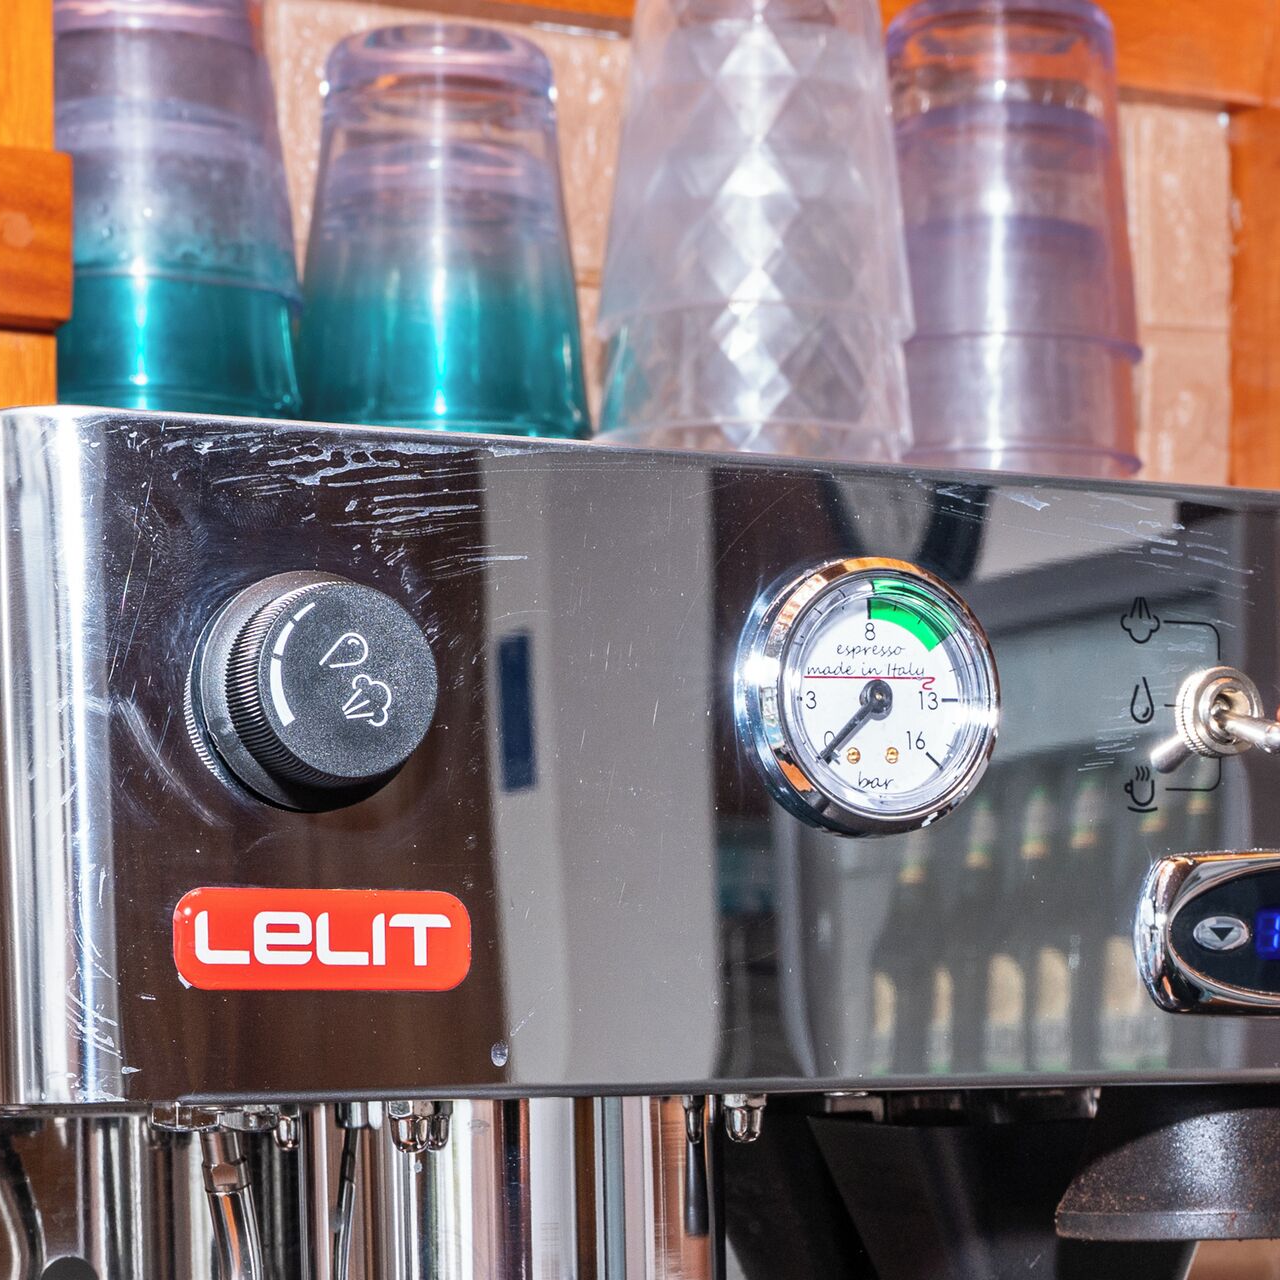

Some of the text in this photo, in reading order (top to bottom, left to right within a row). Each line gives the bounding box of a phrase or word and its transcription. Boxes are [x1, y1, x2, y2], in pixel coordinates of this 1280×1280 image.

[864, 622, 876, 641] 8
[836, 643, 906, 659] espresso
[807, 661, 925, 678] made in Italy
[805, 690, 817, 710] 3
[918, 690, 939, 710] 13
[906, 730, 926, 750] 16
[858, 771, 895, 790] bar
